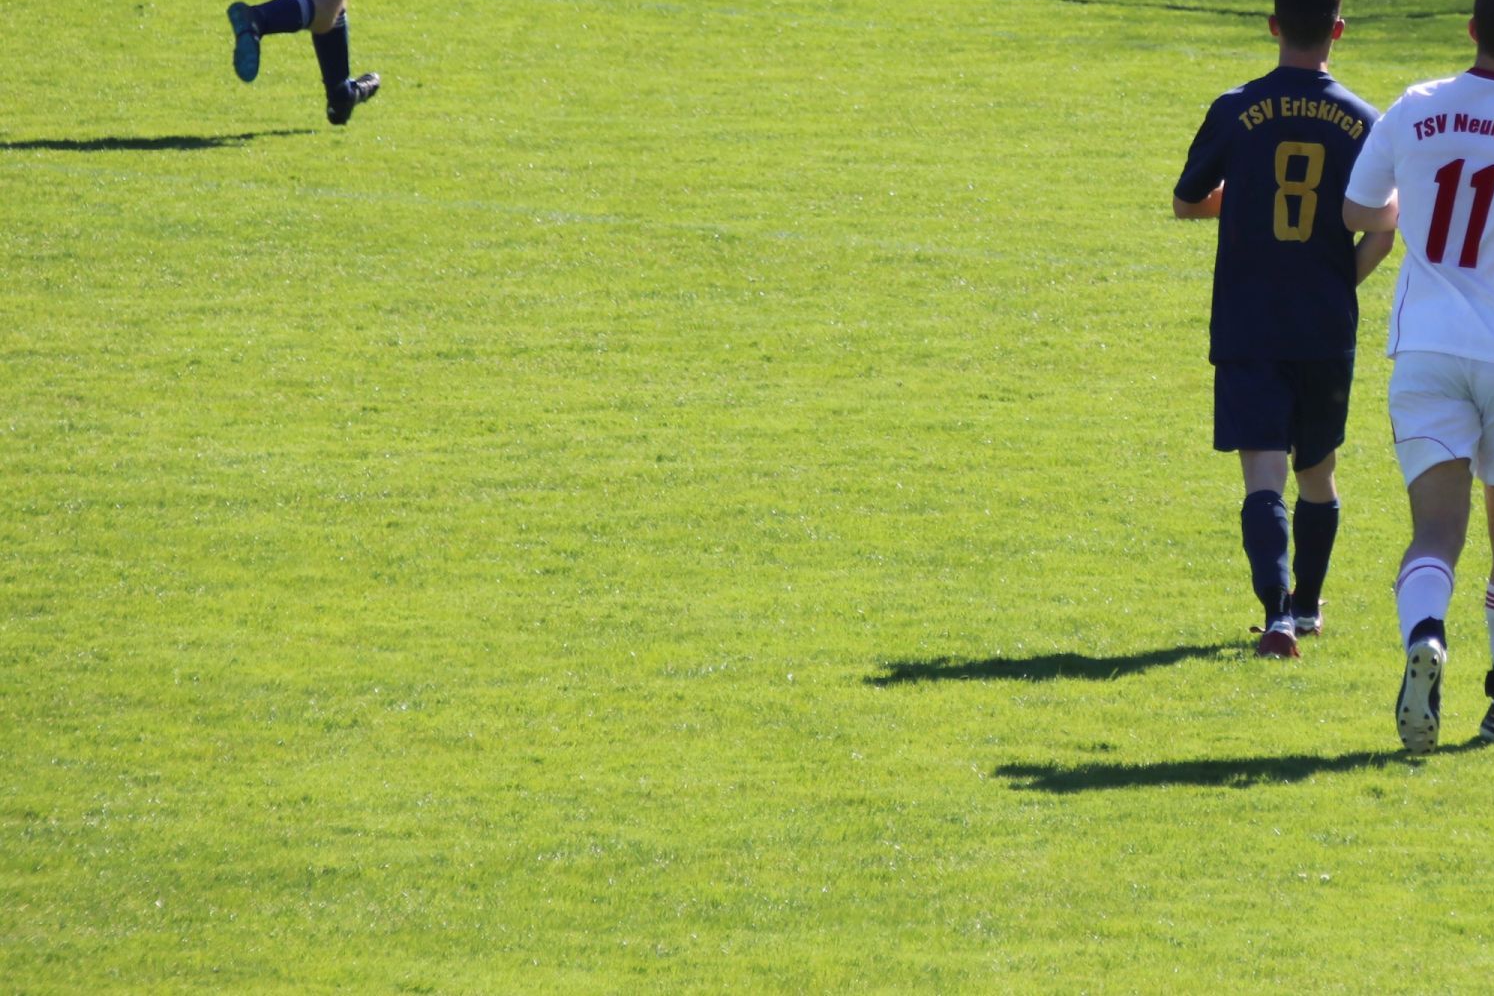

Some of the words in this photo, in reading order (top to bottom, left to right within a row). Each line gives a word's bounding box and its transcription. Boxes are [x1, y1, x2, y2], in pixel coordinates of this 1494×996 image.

[1238, 98, 1274, 130] TSV
[1280, 97, 1364, 140] Eriskirch
[1413, 114, 1447, 141] TSV
[1273, 141, 1326, 243] 8
